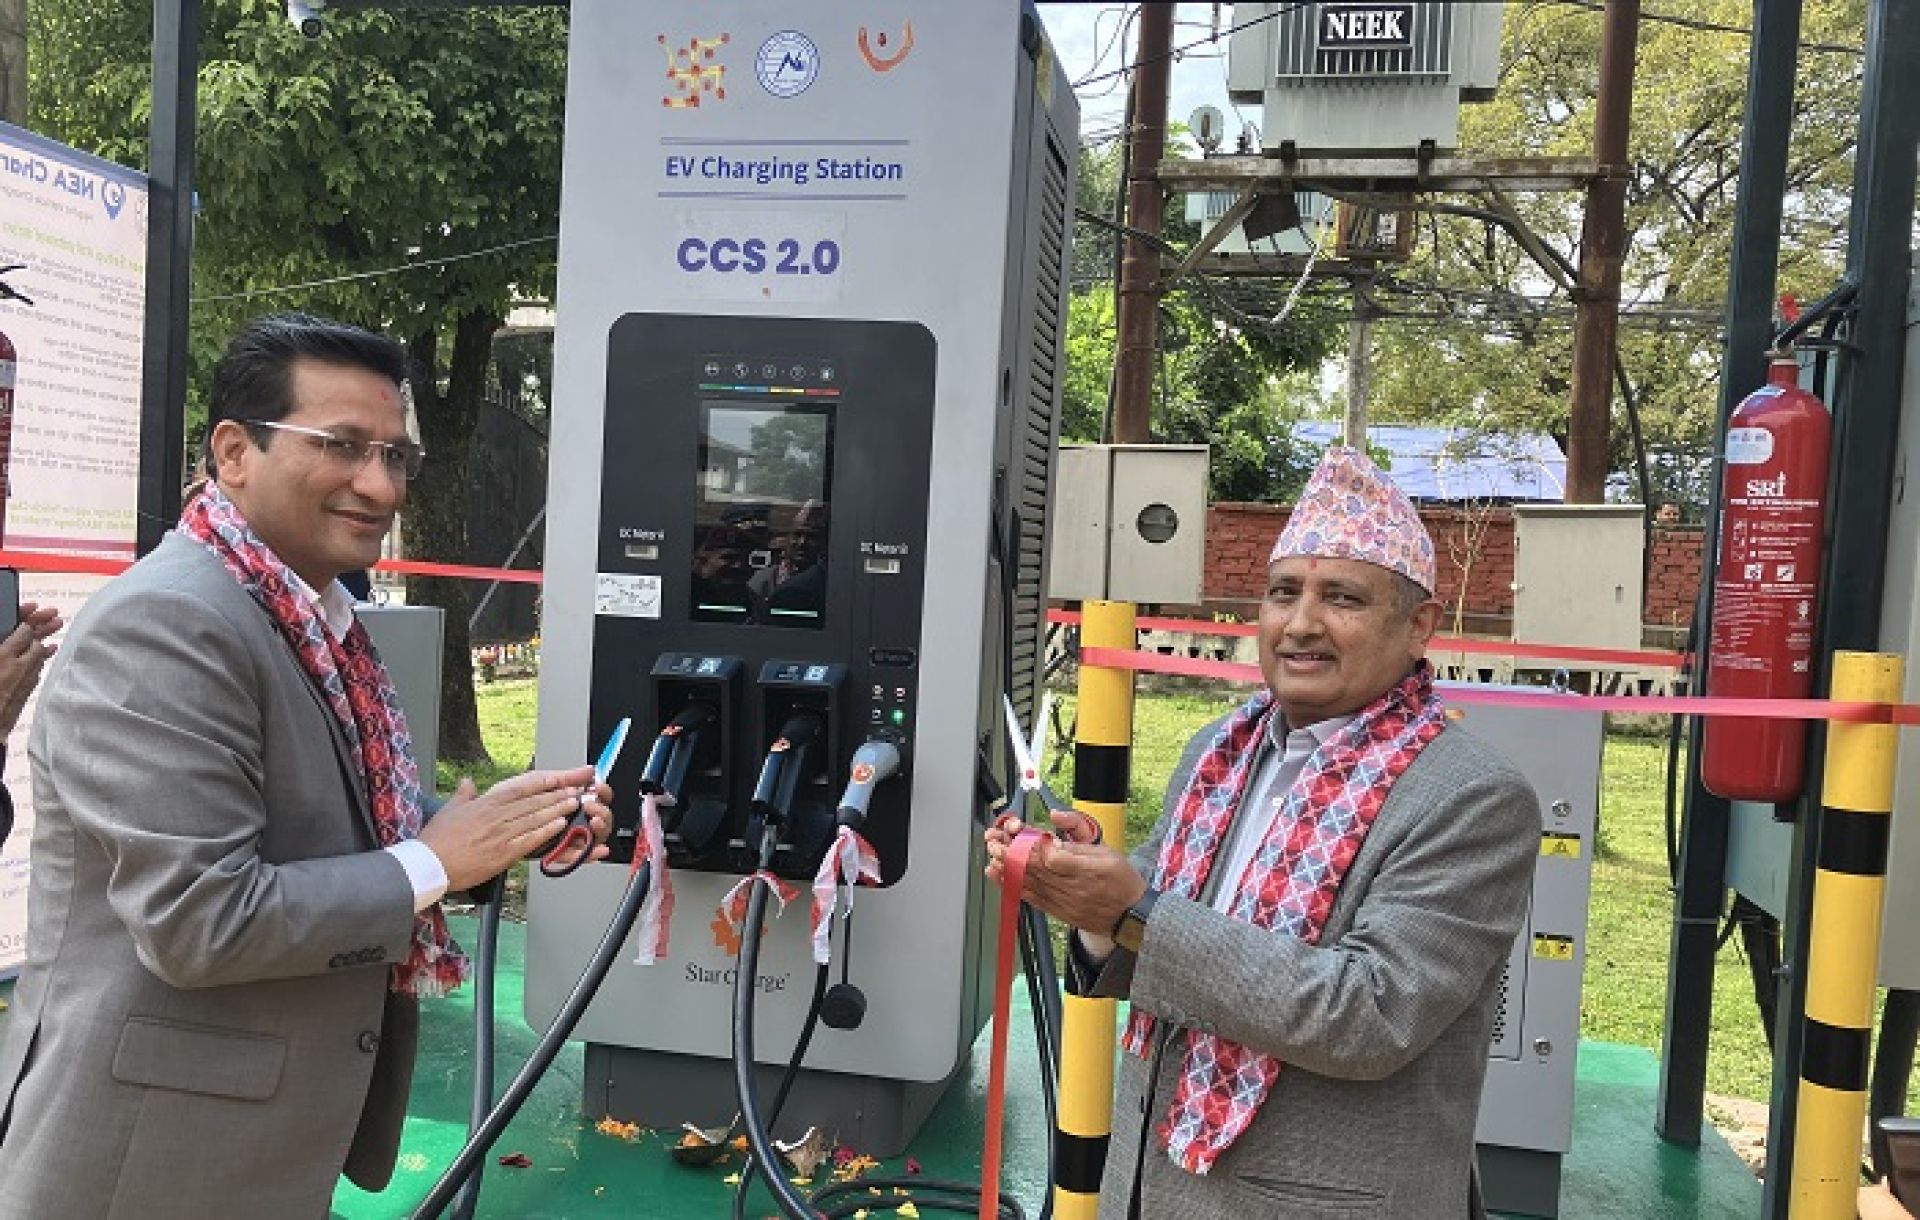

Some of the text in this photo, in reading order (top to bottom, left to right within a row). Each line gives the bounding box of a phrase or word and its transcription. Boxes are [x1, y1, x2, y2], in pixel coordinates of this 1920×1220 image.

[1326, 10, 1405, 41] NEEK
[665, 156, 903, 184] EV Charging Station
[677, 238, 840, 275] CCS 2.0
[697, 658, 722, 673] A
[803, 665, 829, 681] B
